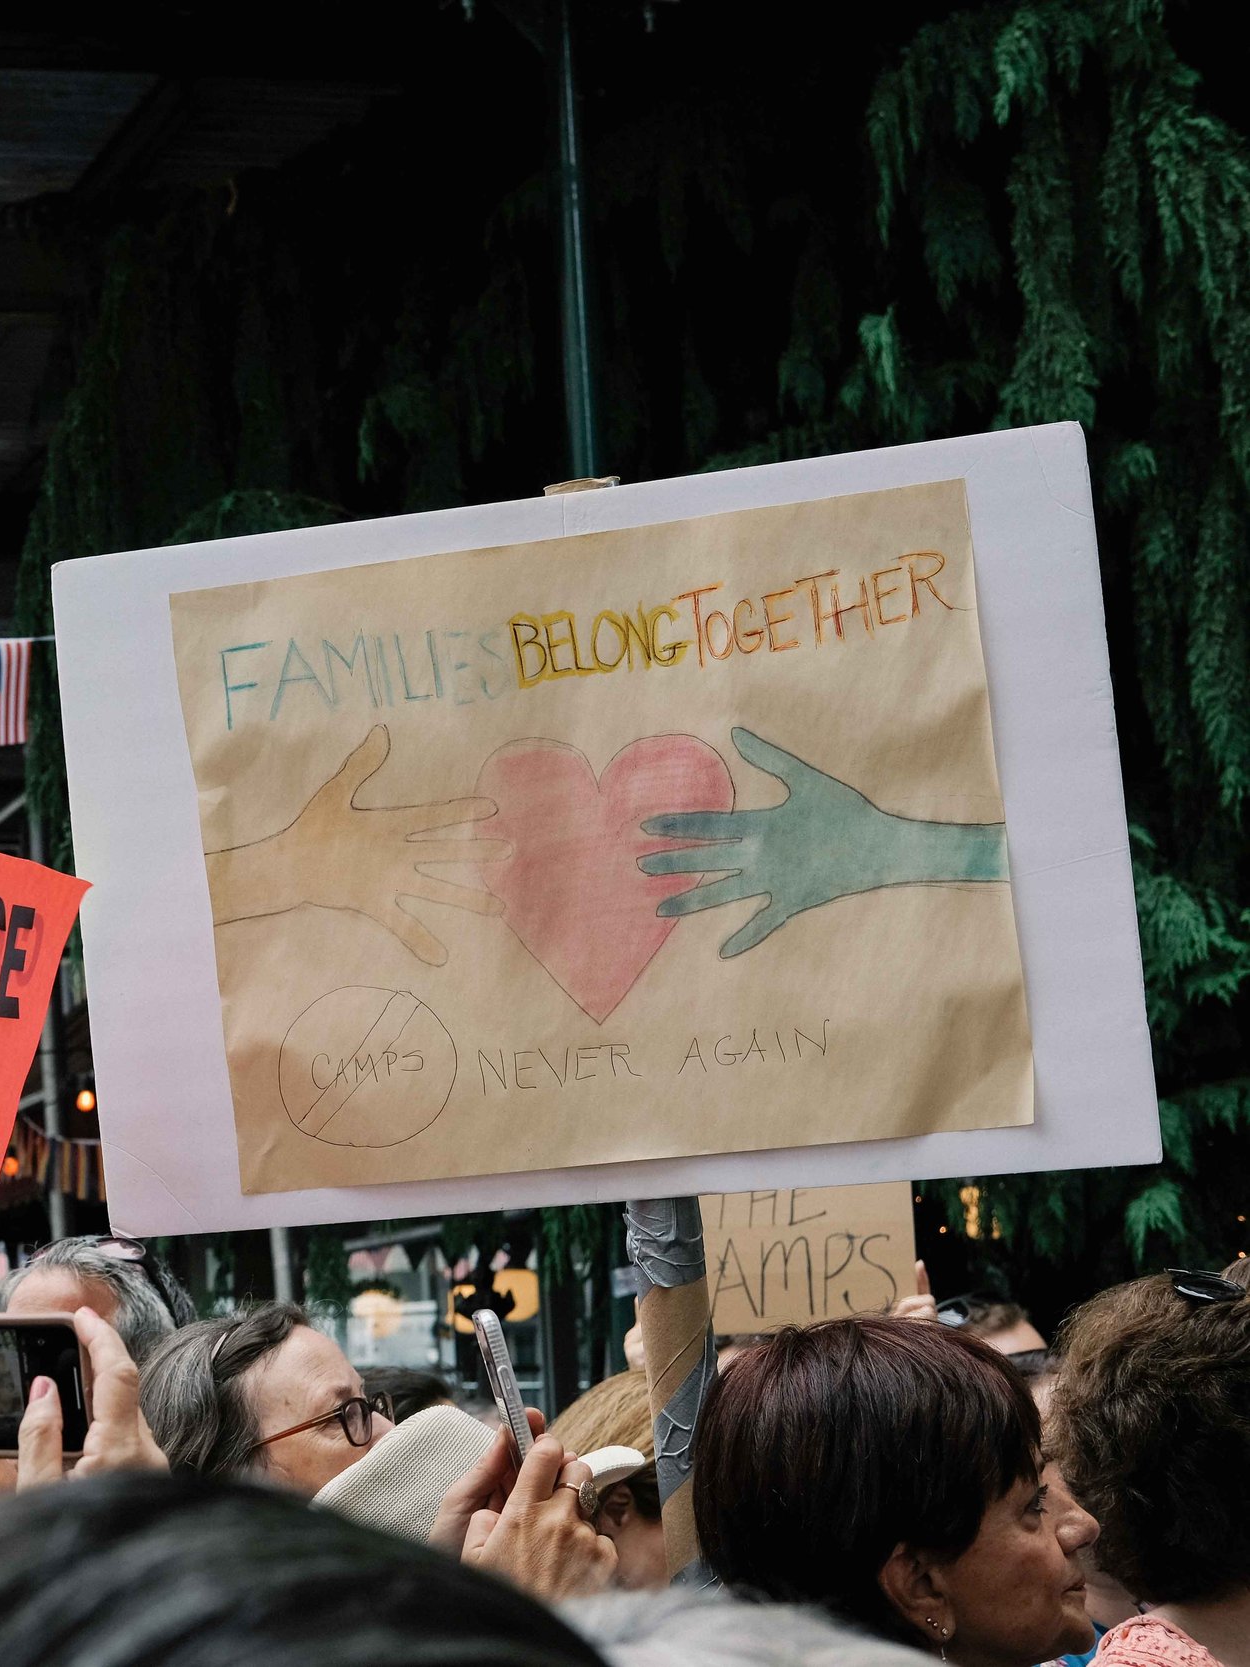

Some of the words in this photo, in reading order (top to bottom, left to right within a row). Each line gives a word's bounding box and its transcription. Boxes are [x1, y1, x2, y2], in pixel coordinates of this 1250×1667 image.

[219, 627, 506, 731] FAMILIES
[509, 602, 691, 689] BELONG
[673, 552, 955, 669] TOGETHER
[310, 1049, 424, 1087] CAMPS
[476, 1043, 643, 1095] NEVER
[678, 1018, 830, 1077] AGAIN
[711, 1232, 898, 1318] AMPS
